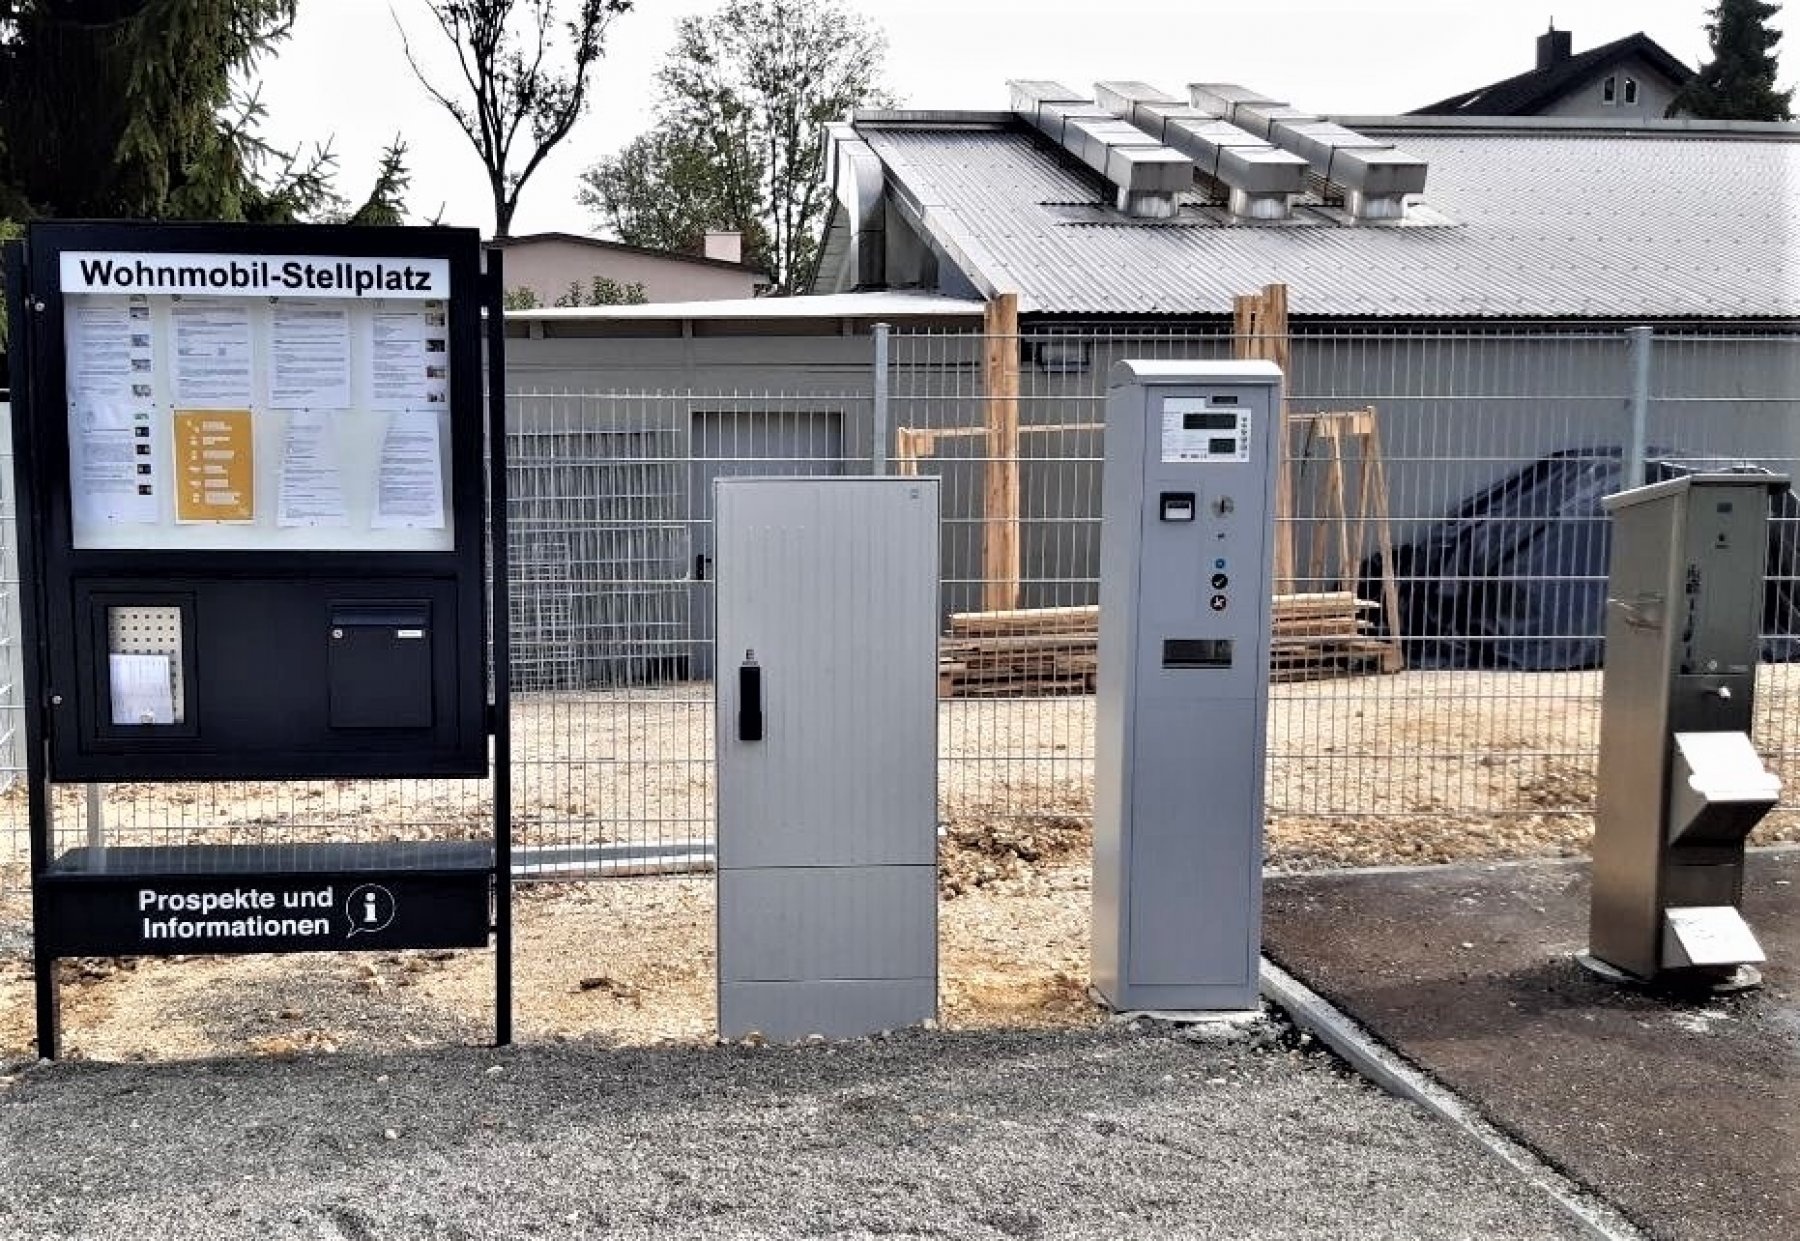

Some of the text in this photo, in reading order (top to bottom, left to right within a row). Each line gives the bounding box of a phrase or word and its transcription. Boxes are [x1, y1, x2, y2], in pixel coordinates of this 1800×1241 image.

[80, 259, 433, 295] Wohnmobil-Stellplatz
[138, 886, 334, 914] Prospekte und
[142, 915, 331, 939] Informationen
